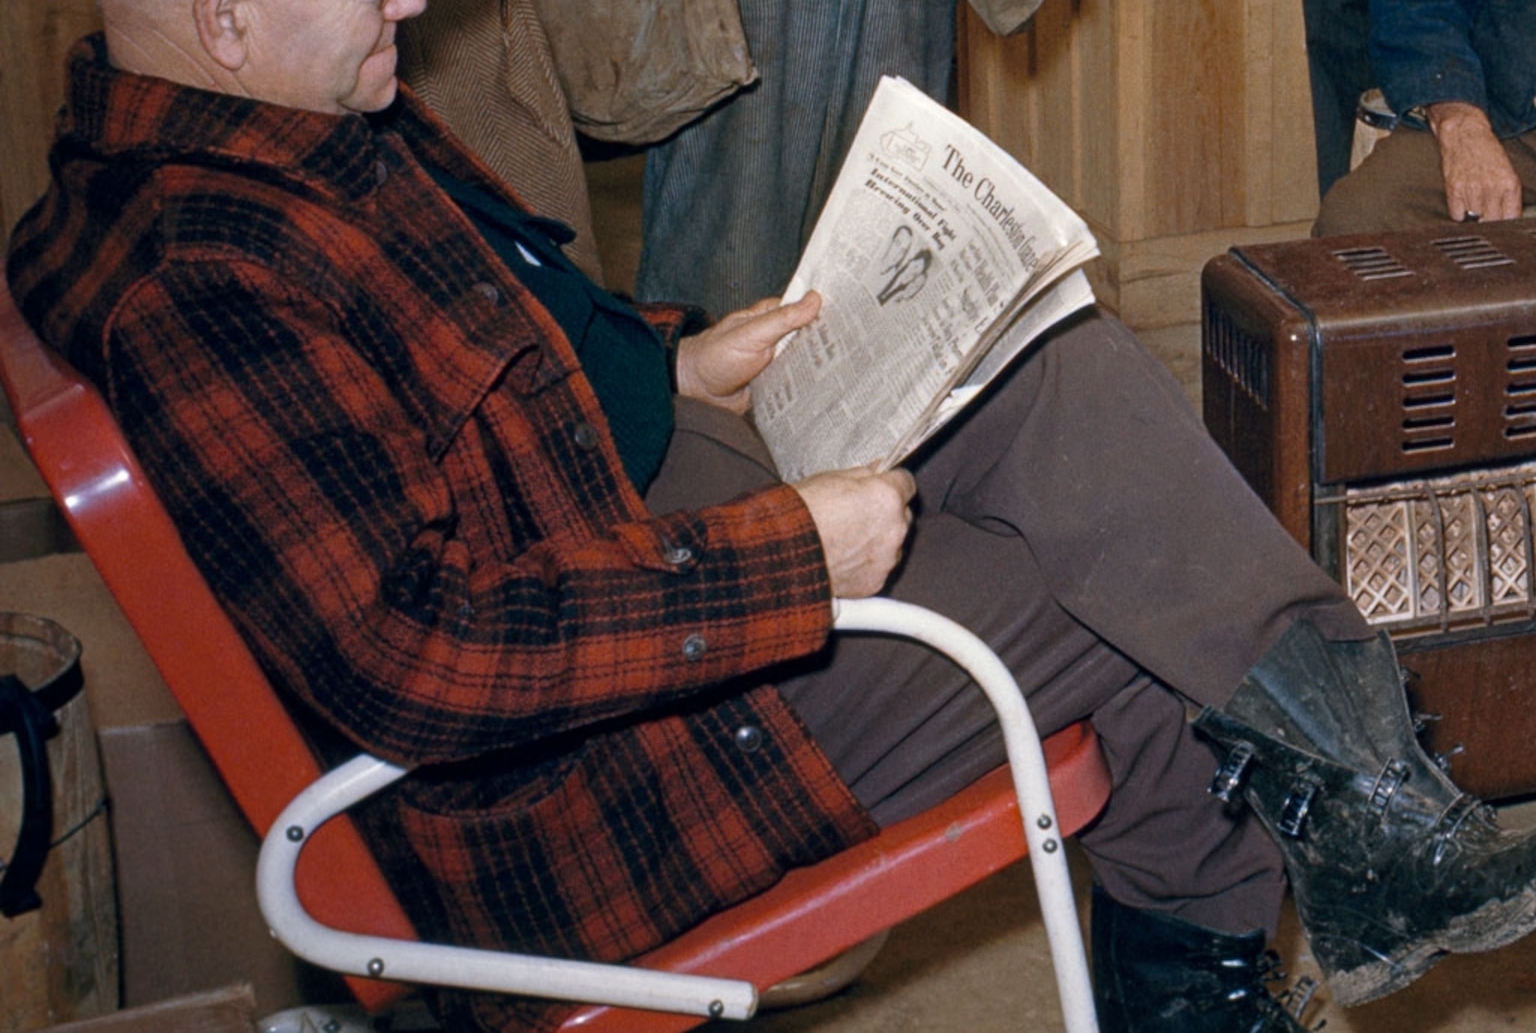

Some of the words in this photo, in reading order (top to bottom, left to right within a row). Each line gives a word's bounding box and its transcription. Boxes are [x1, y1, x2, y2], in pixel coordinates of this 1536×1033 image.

[870, 167, 938, 220] International
[943, 143, 974, 189] The
[974, 177, 1026, 251] Charleston
